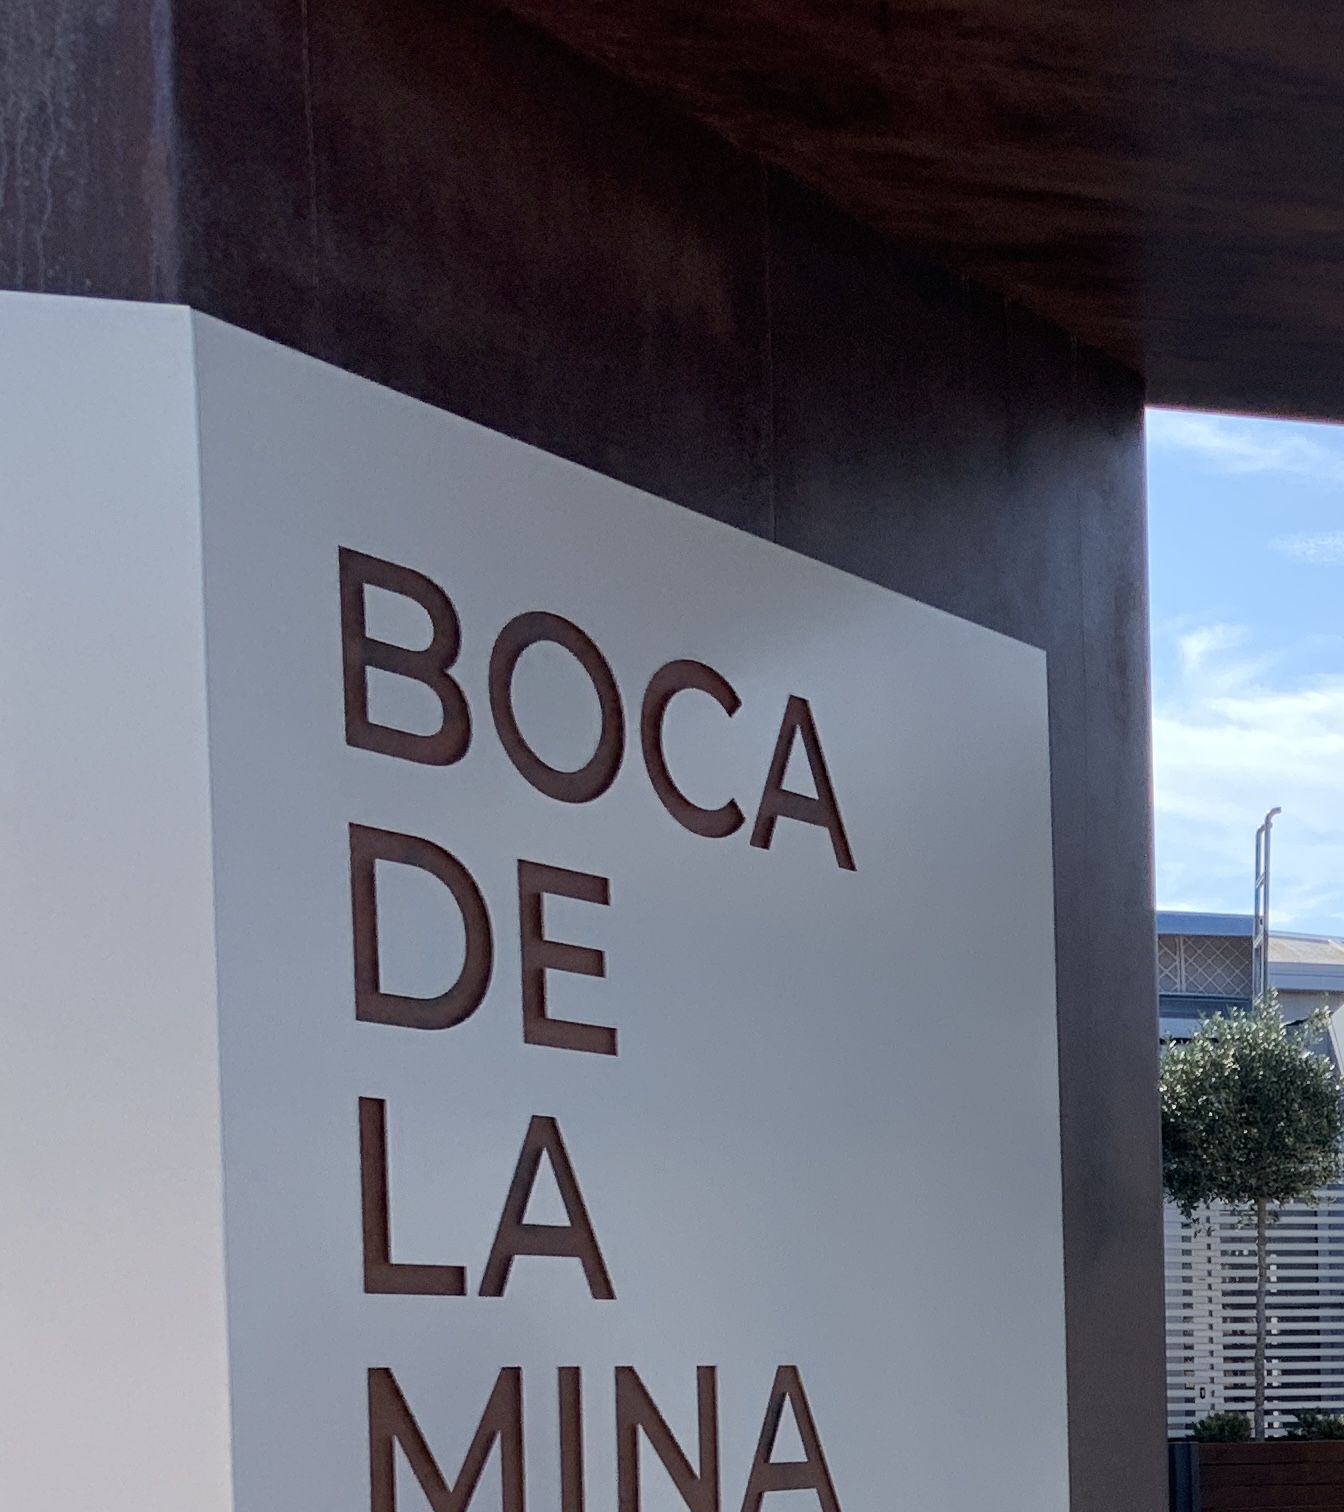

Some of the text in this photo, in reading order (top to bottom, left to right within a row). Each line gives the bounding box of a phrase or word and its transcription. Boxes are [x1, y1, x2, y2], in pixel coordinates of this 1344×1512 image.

[337, 544, 858, 873] BOCA
[347, 821, 619, 1058] DE
[357, 1095, 618, 1301] LA
